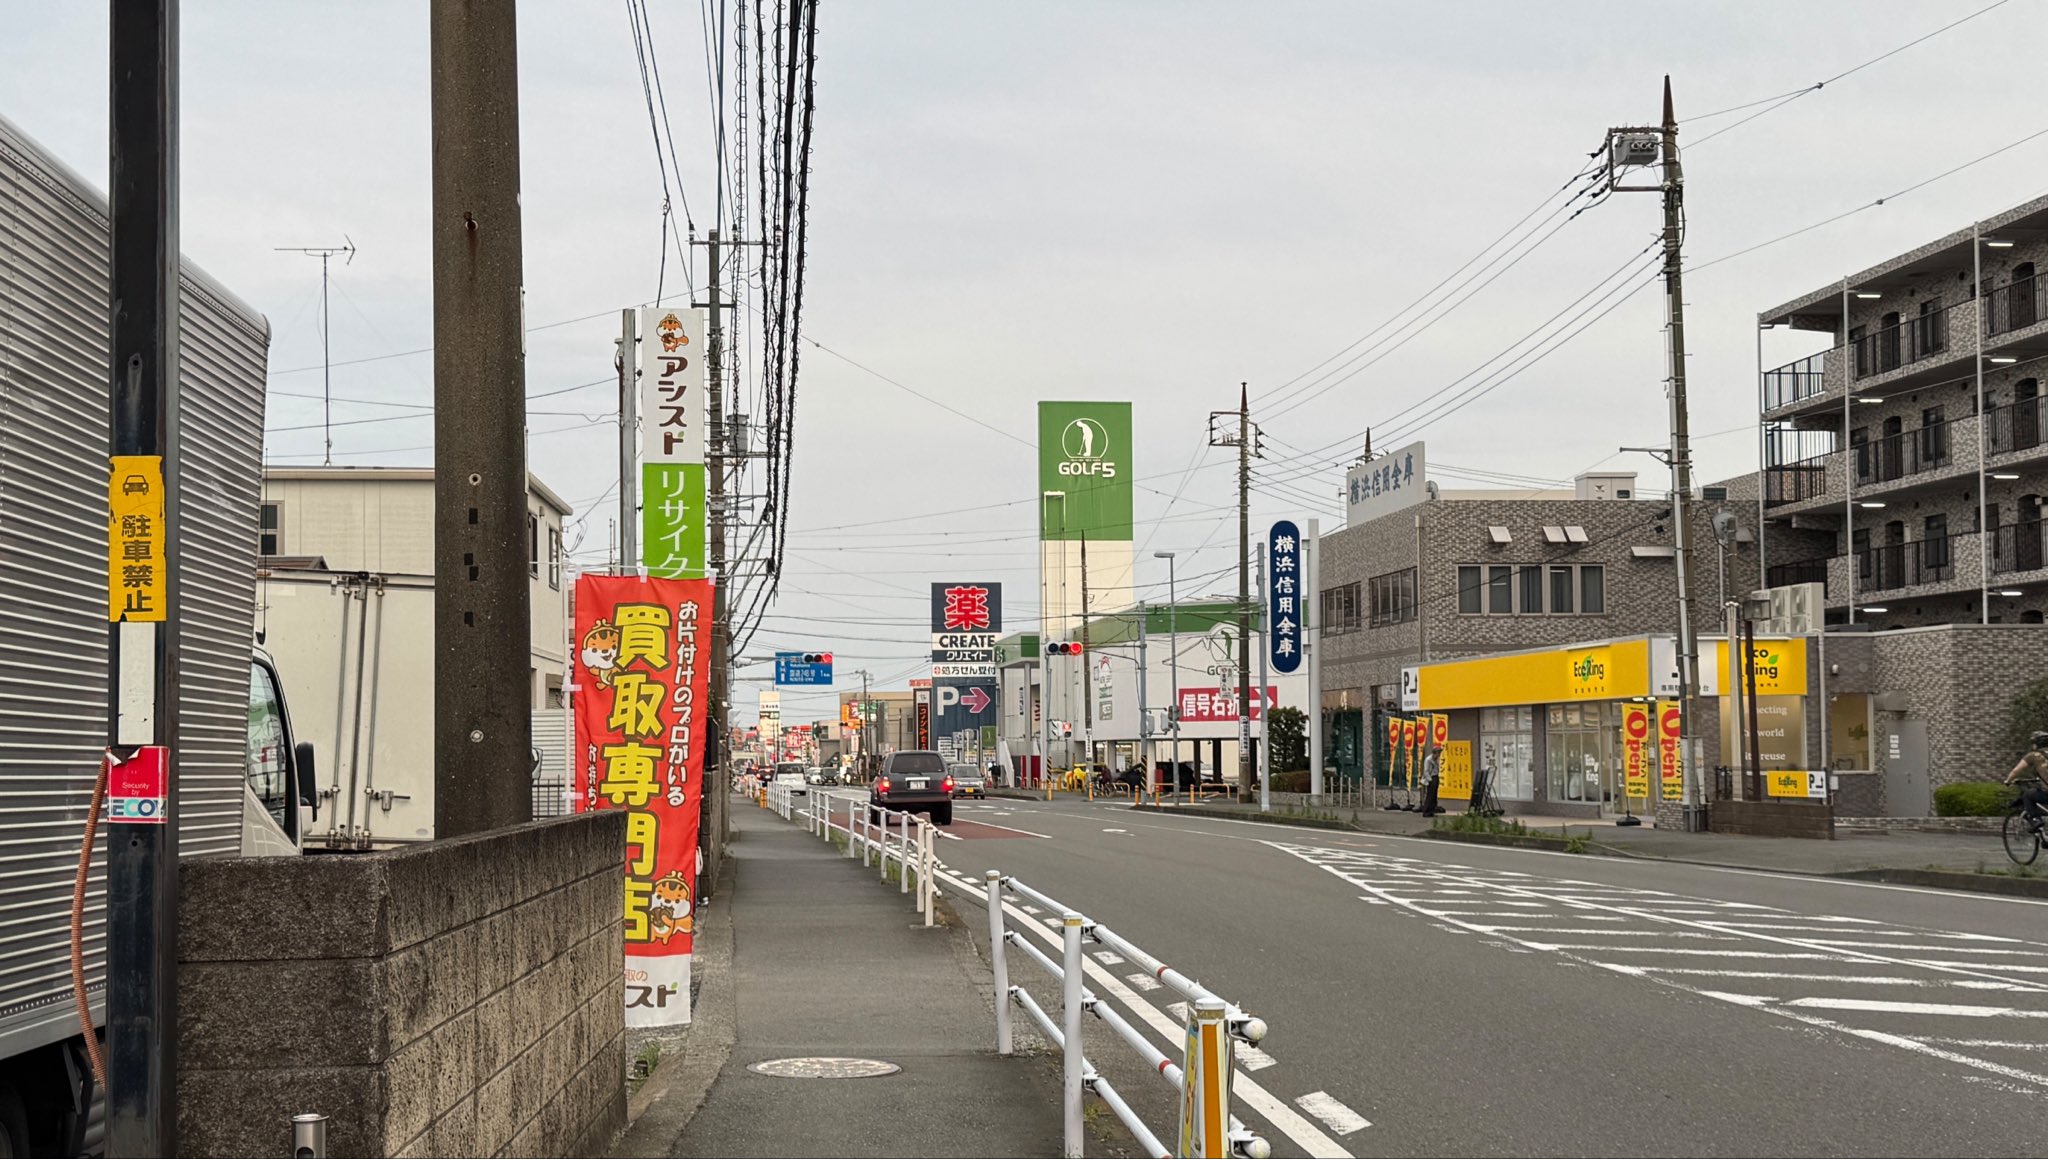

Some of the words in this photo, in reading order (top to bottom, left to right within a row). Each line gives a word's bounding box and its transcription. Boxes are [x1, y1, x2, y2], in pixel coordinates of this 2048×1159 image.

[657, 355, 688, 455] アシスト
[1058, 462, 1115, 478] GOLF5
[1350, 453, 1414, 505] 横浜信用金庫
[121, 514, 153, 613] 駐車禁止
[944, 586, 990, 630] 薬
[1274, 535, 1296, 658] 横浜信用金庫
[939, 635, 995, 648] CREATE
[946, 651, 988, 661] クリエイト
[942, 665, 995, 676] 処方せん受付
[1746, 663, 1778, 678] ing
[1404, 671, 1409, 695] P
[666, 601, 699, 807] お片付けのプロがいる
[937, 686, 959, 716] P
[1182, 693, 1240, 717] 信号右折
[1757, 728, 1784, 737] world
[122, 782, 150, 790] Security
